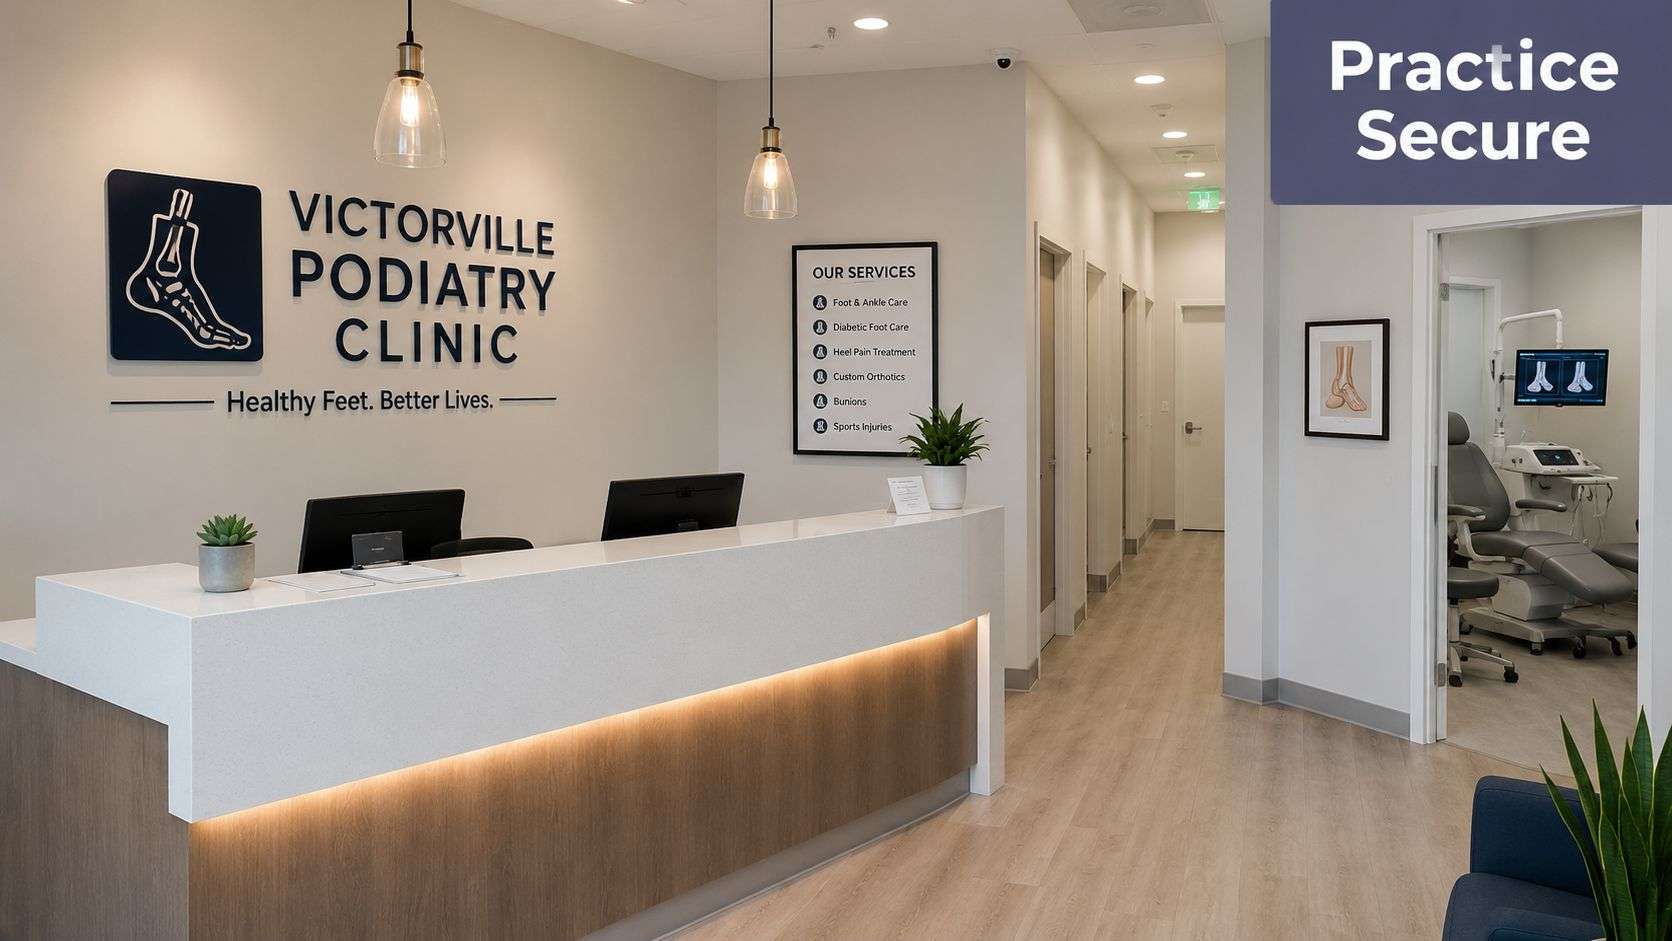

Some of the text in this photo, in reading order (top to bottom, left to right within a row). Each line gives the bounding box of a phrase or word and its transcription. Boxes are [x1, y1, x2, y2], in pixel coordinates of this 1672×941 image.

[288, 189, 555, 256] VICTORVILLE
[812, 265, 916, 279] OUR SERVICES
[291, 248, 556, 311] PODIATRY
[833, 298, 908, 307] Foot & Ankle Care
[833, 323, 909, 332] Diabetic Foot Care
[335, 317, 519, 364] CLINIC
[833, 348, 916, 357] Heel Pain Treatment
[833, 373, 905, 381] Custom Orthotics
[227, 388, 494, 417] Healthy Feet. Better Lives.
[833, 397, 867, 406] Bunions
[833, 422, 893, 433] Sports Injuries
